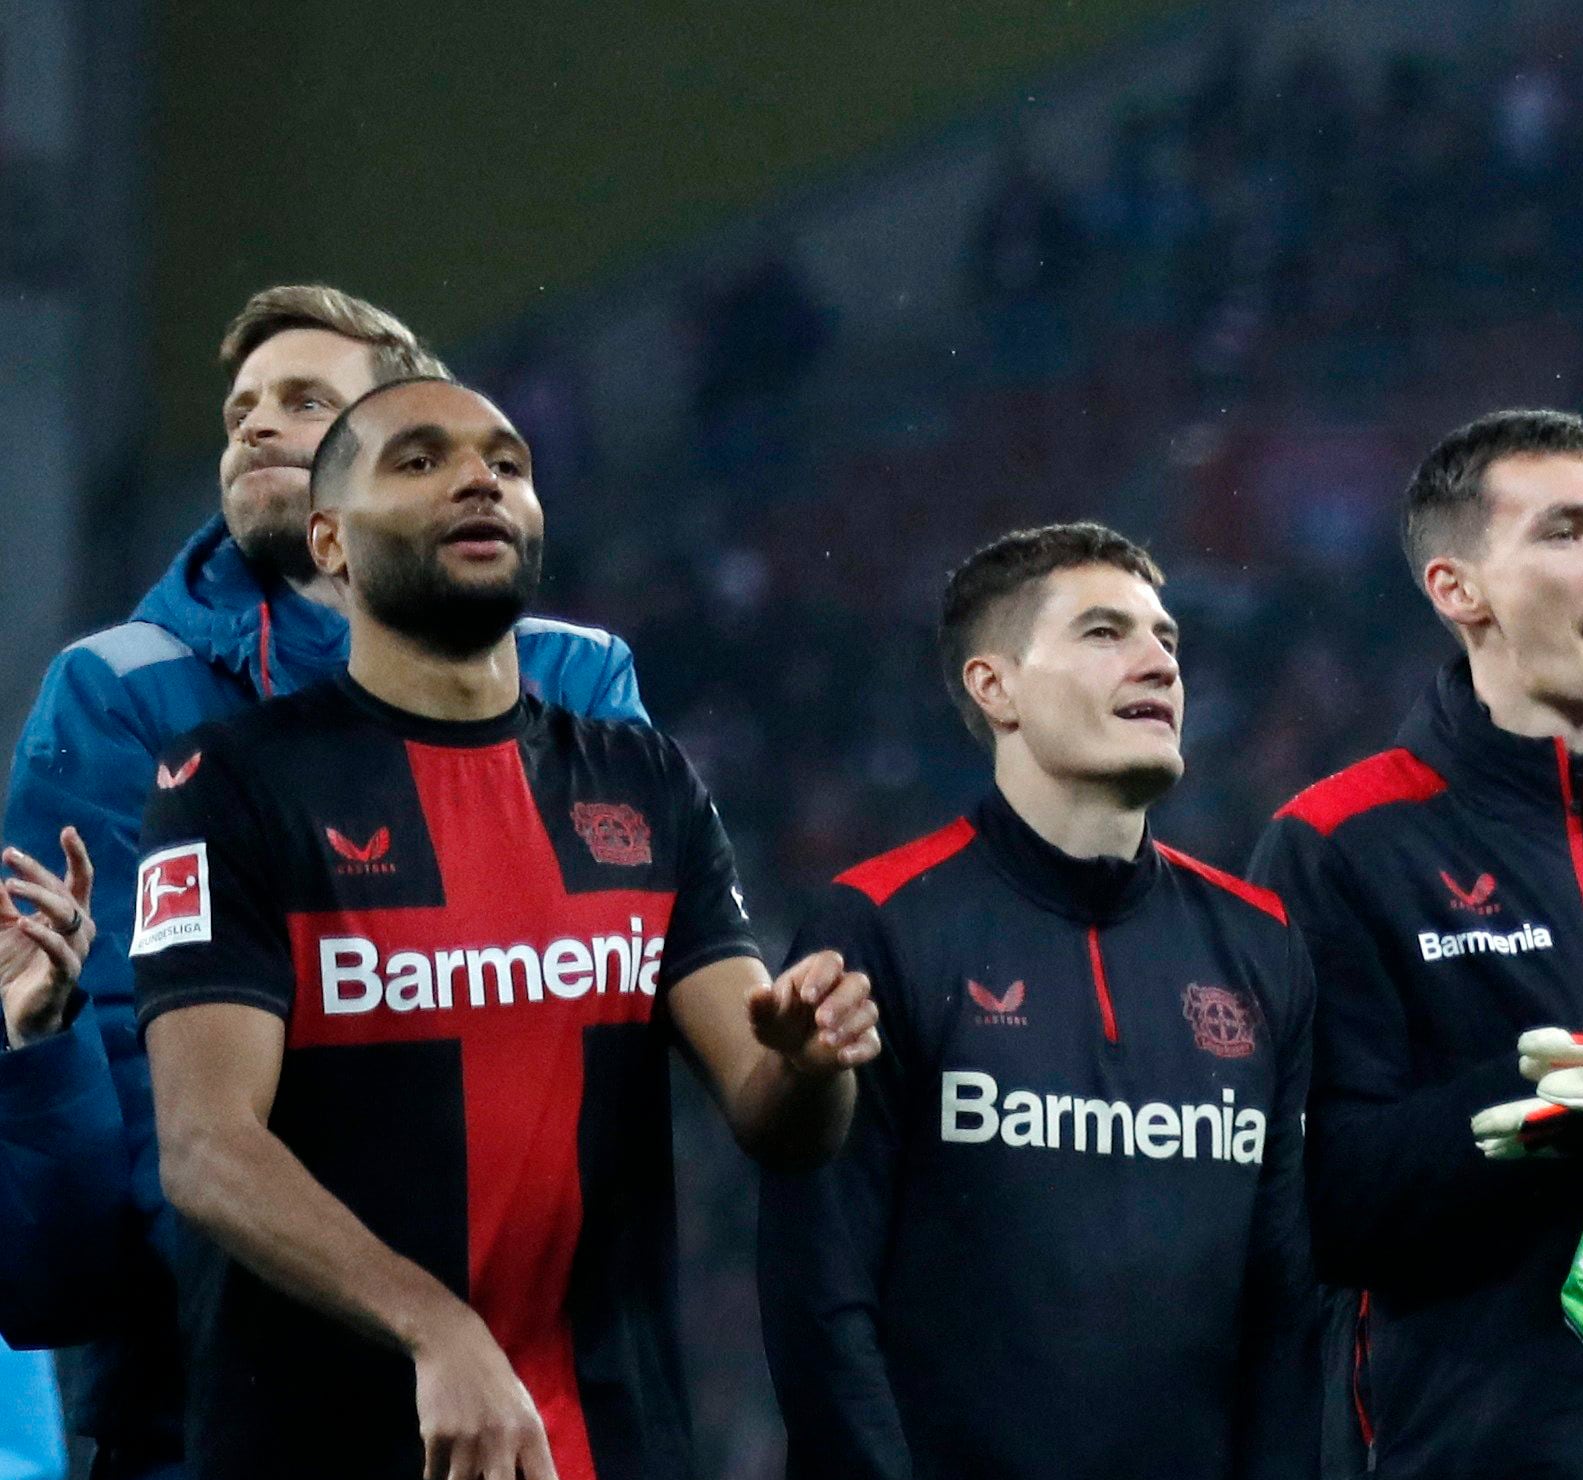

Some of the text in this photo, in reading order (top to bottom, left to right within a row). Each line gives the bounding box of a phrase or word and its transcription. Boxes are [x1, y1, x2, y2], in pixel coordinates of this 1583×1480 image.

[319, 915, 665, 1015] Barmenia
[1419, 921, 1553, 962] Barmenia
[940, 1070, 1267, 1165] Barmenia
